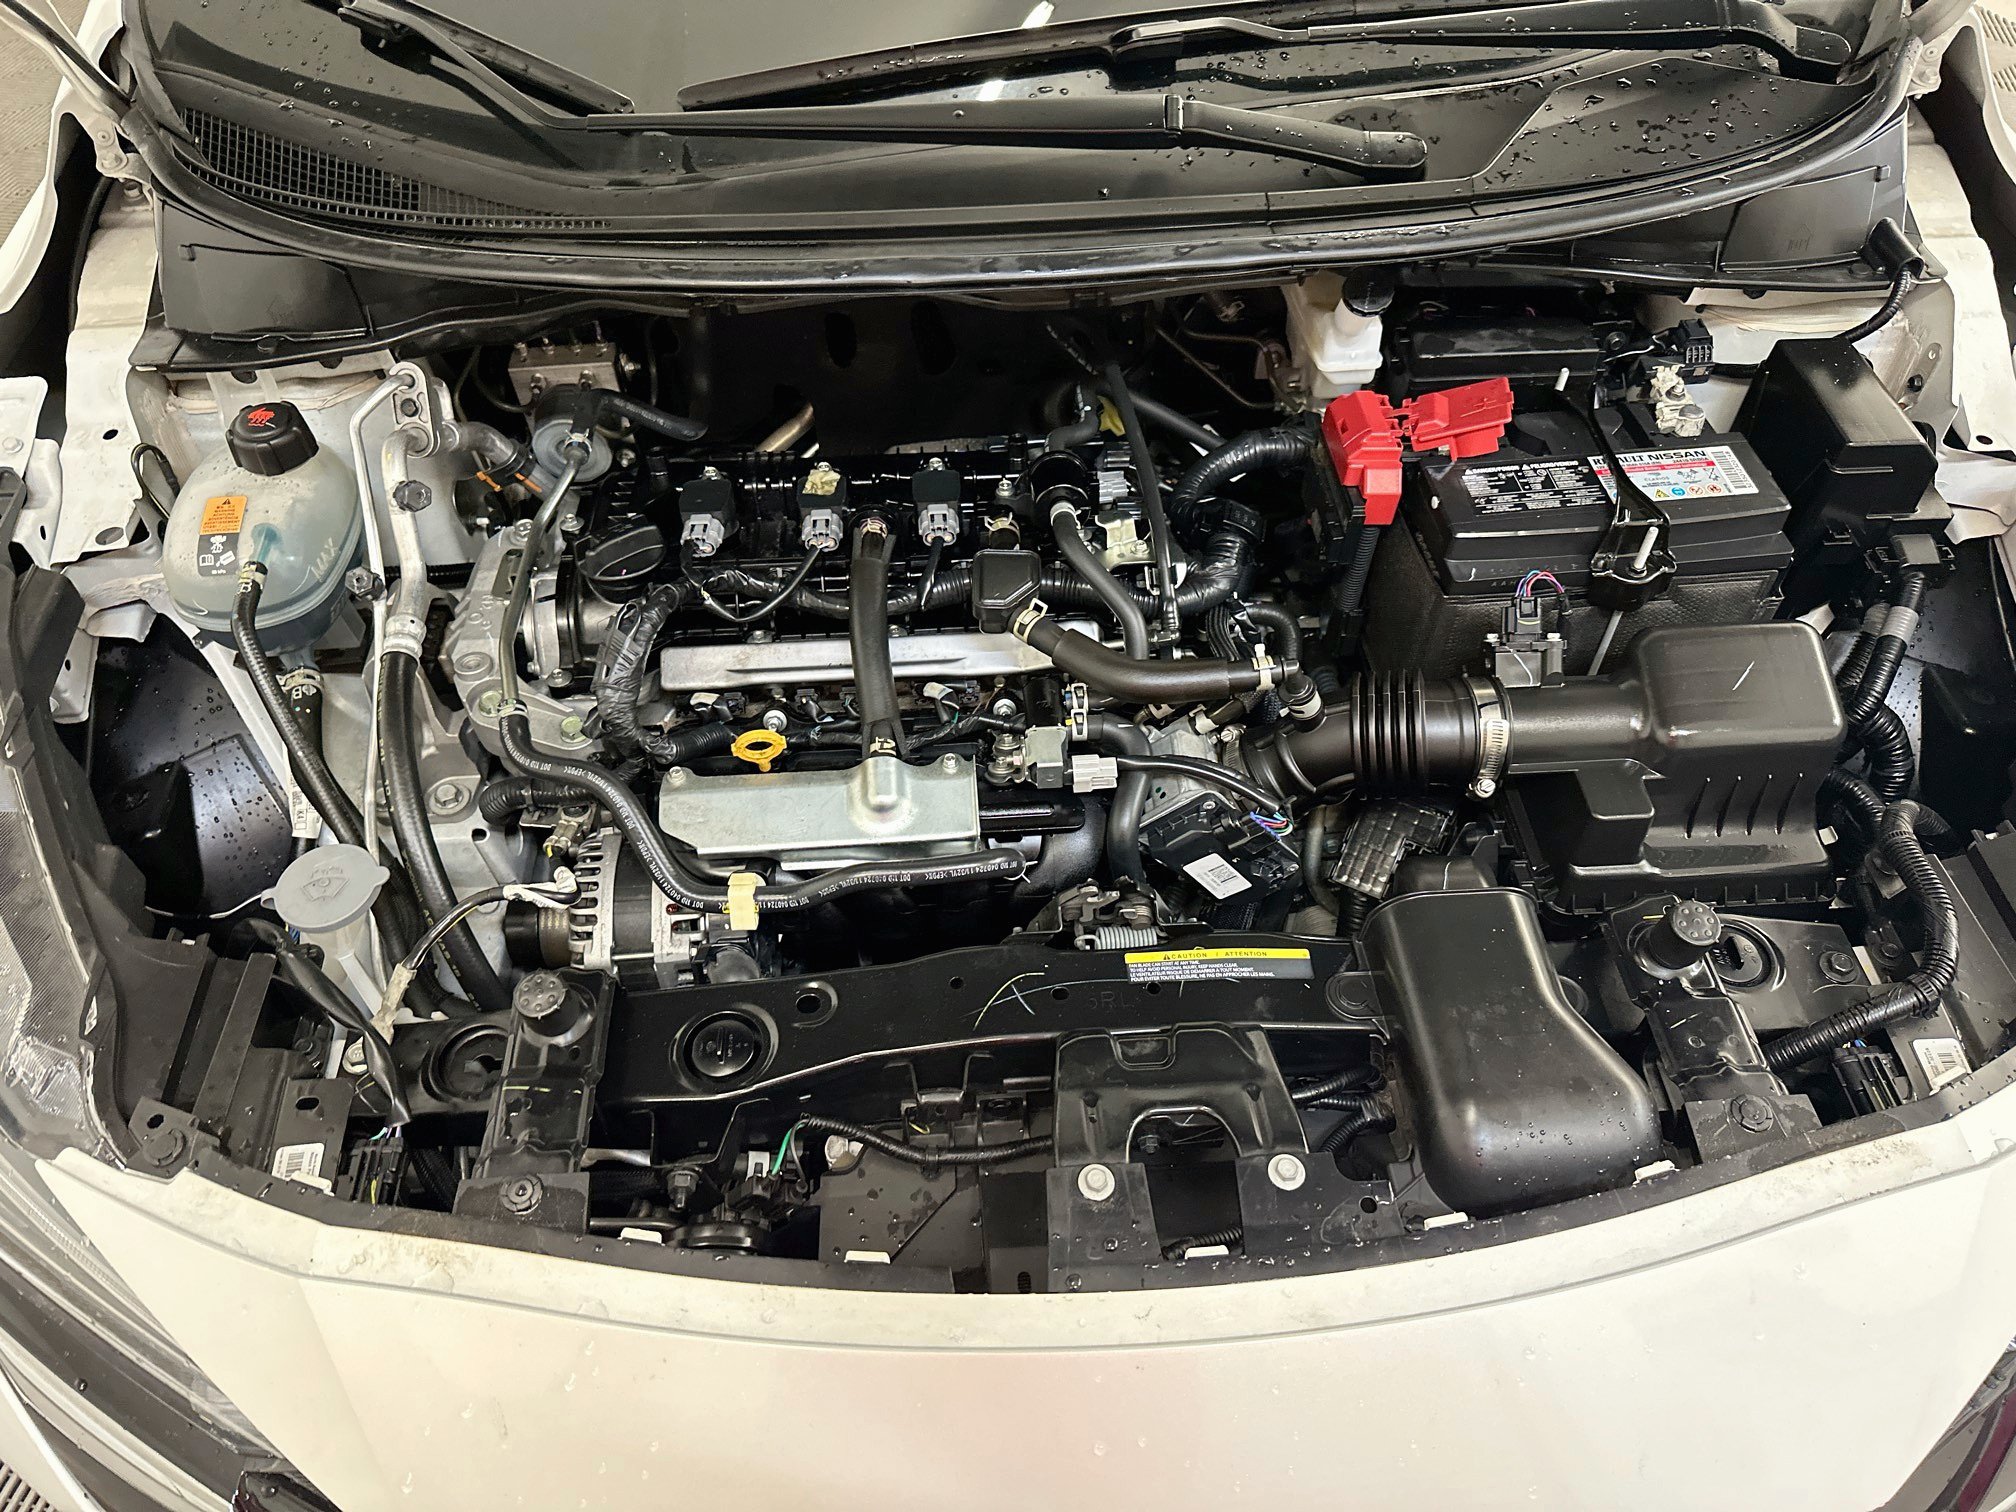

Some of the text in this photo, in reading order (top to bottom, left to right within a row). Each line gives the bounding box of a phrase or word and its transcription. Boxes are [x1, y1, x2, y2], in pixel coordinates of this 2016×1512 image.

[1649, 450, 1707, 461] NISSAN
[975, 863, 999, 873] 040724
[899, 873, 911, 882] DOT
[662, 880, 681, 900] 040724
[692, 901, 704, 909] DOT
[767, 900, 788, 909] 040724
[1171, 952, 1207, 960] CAUTION
